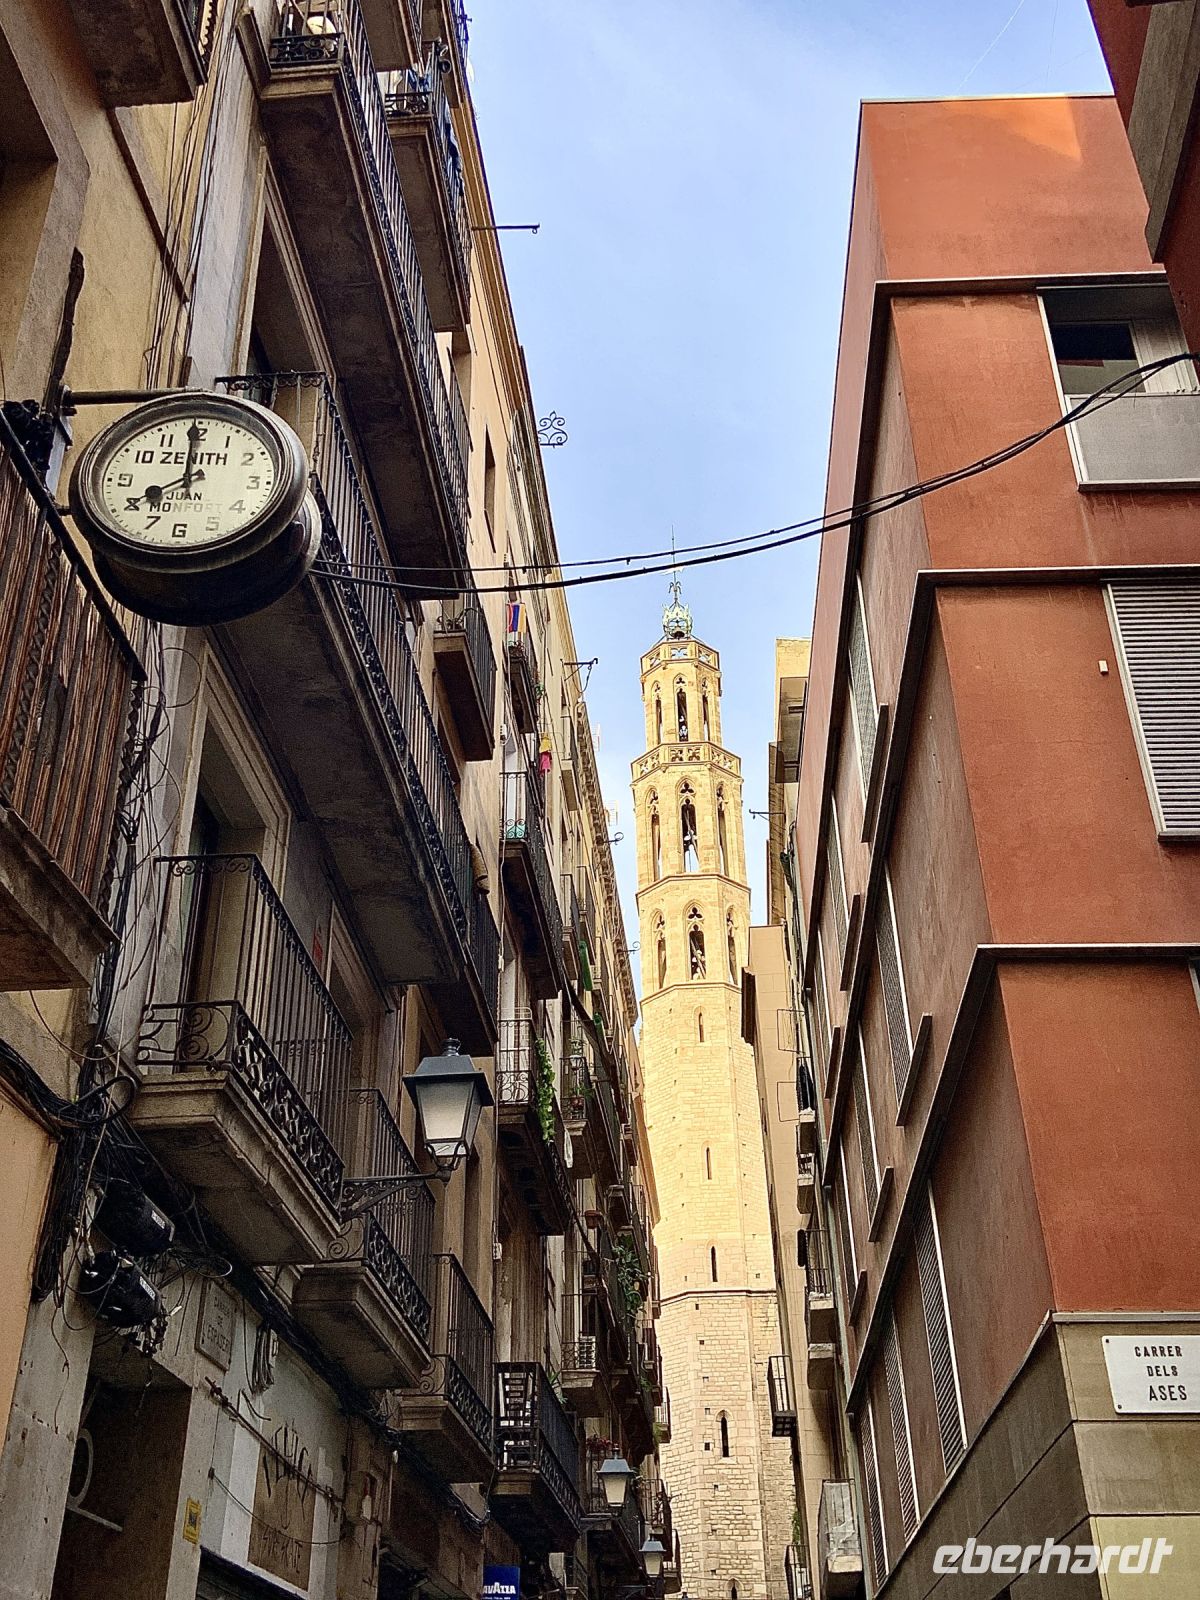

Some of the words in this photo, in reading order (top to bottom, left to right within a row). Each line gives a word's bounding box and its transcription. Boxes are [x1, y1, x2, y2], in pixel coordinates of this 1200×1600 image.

[159, 434, 174, 447] 11
[225, 435, 231, 448] 1
[135, 450, 155, 464] 10
[160, 451, 228, 465] ZENITH
[241, 452, 255, 466] 2
[117, 473, 134, 487] 9
[246, 475, 261, 490] 3
[166, 491, 203, 501] JUAN
[123, 498, 141, 511] 8
[229, 499, 246, 514] 4
[144, 515, 161, 530] 7
[205, 516, 220, 531] 5
[171, 523, 188, 538] 6
[1134, 1345, 1183, 1357] CARRER
[1146, 1365, 1178, 1377] DELS
[1149, 1385, 1187, 1401] ASES
[483, 1581, 516, 1594] AVAZZA
